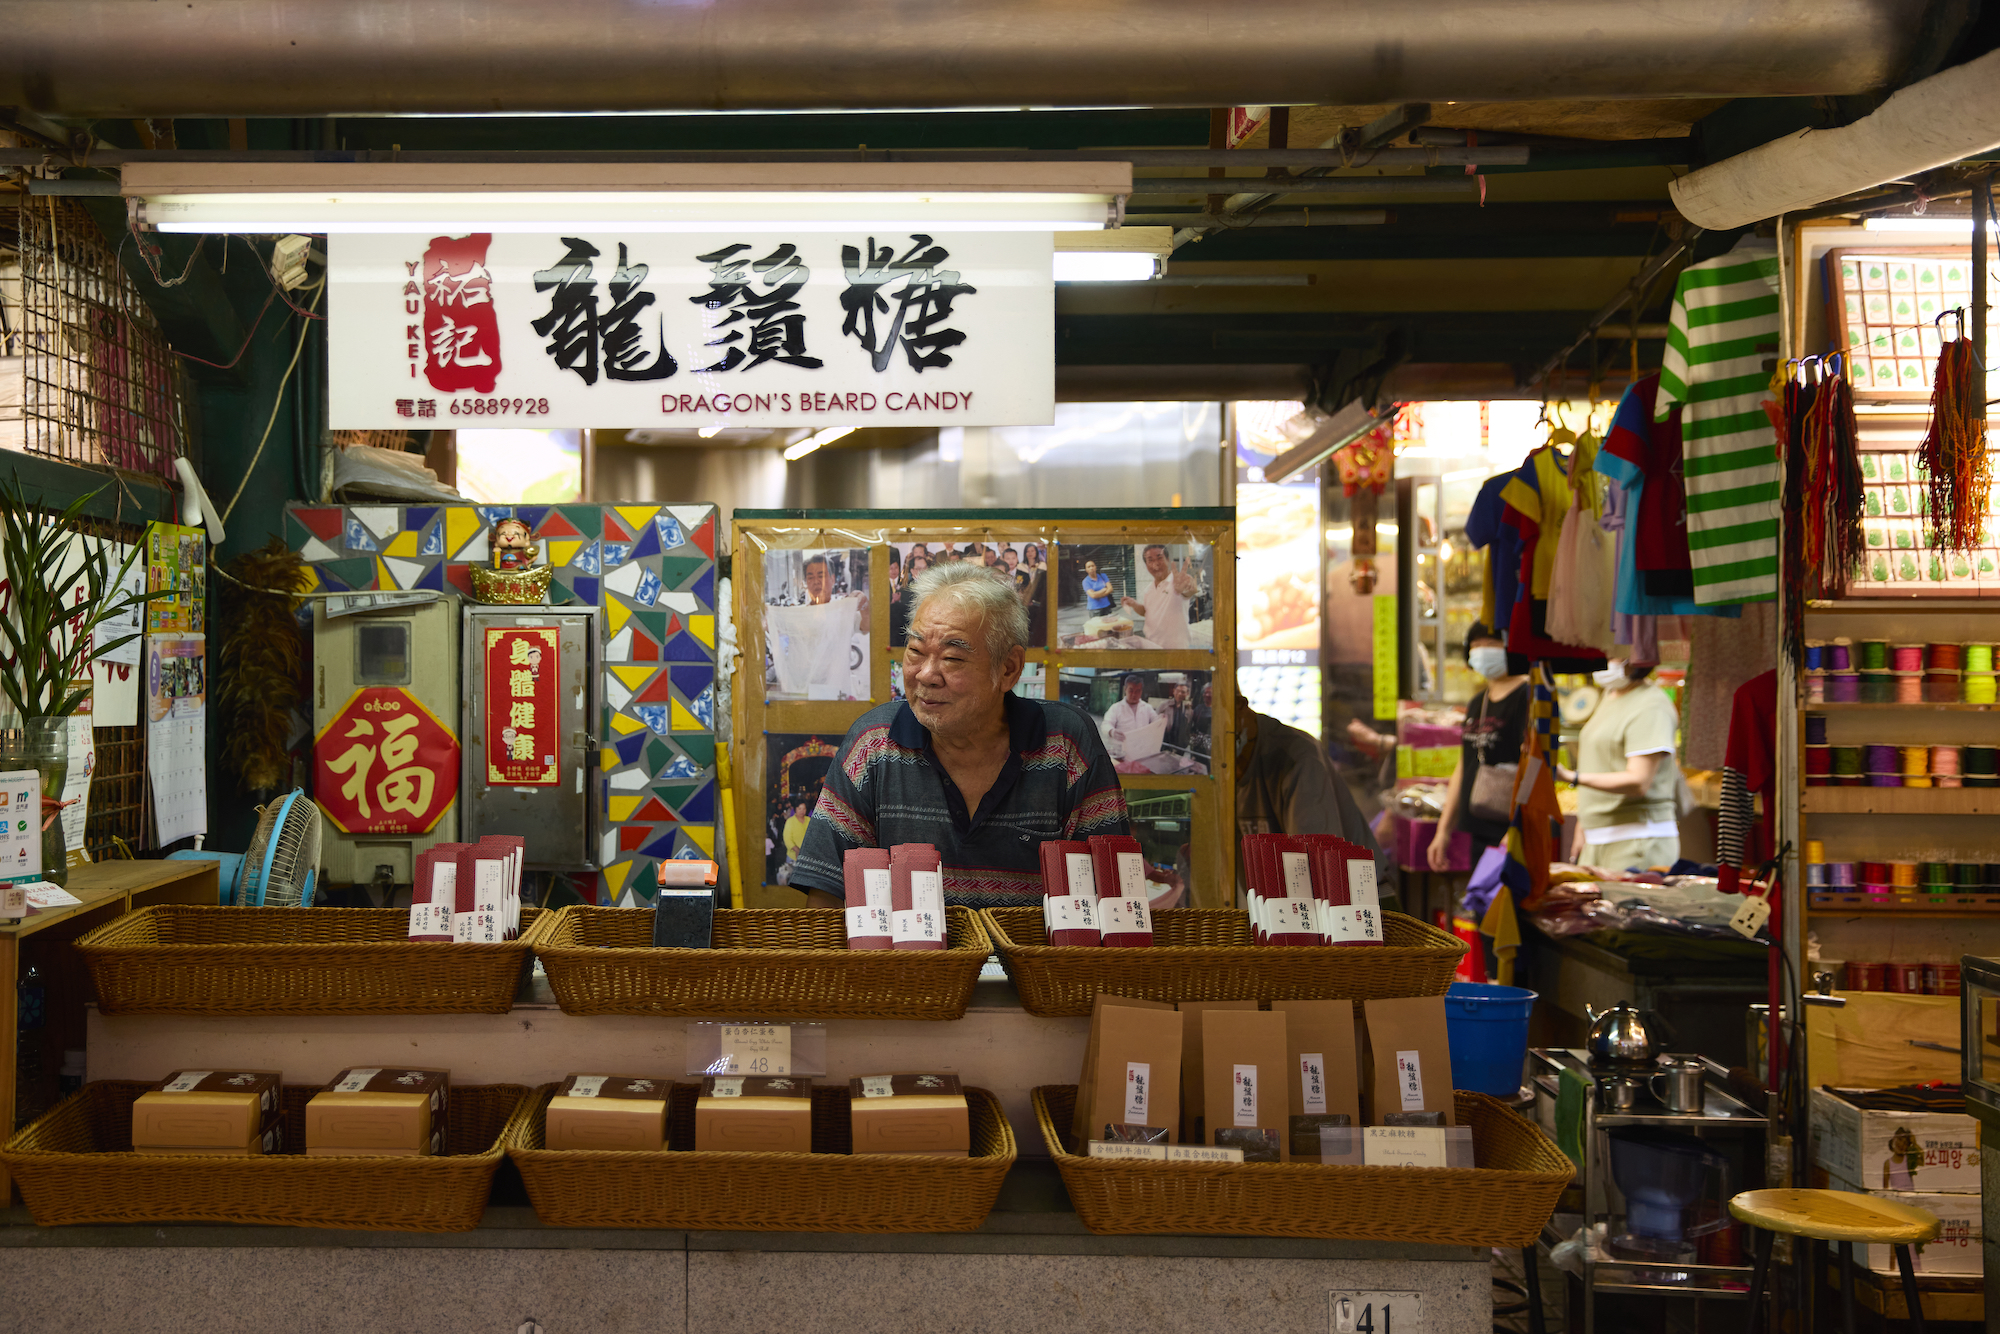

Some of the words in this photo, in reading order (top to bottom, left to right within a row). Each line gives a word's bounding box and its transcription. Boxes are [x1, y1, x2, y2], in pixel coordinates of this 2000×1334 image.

[404, 261, 421, 315] YAU
[531, 234, 977, 385] 龍鬚糖
[407, 325, 420, 378] KEI
[395, 398, 437, 417] 電話
[450, 398, 549, 415] 65889928
[662, 392, 791, 414] DRAGON'S
[799, 391, 877, 412] BEARD
[885, 390, 973, 412] CANDY
[509, 637, 536, 761] 身體健康
[325, 713, 435, 819] 福
[749, 1057, 769, 1073] 48
[1370, 1128, 1416, 1138] 黑芝麻軟糖
[1925, 1149, 1963, 1169] 쏘피앙
[1356, 1303, 1390, 1334] 41
